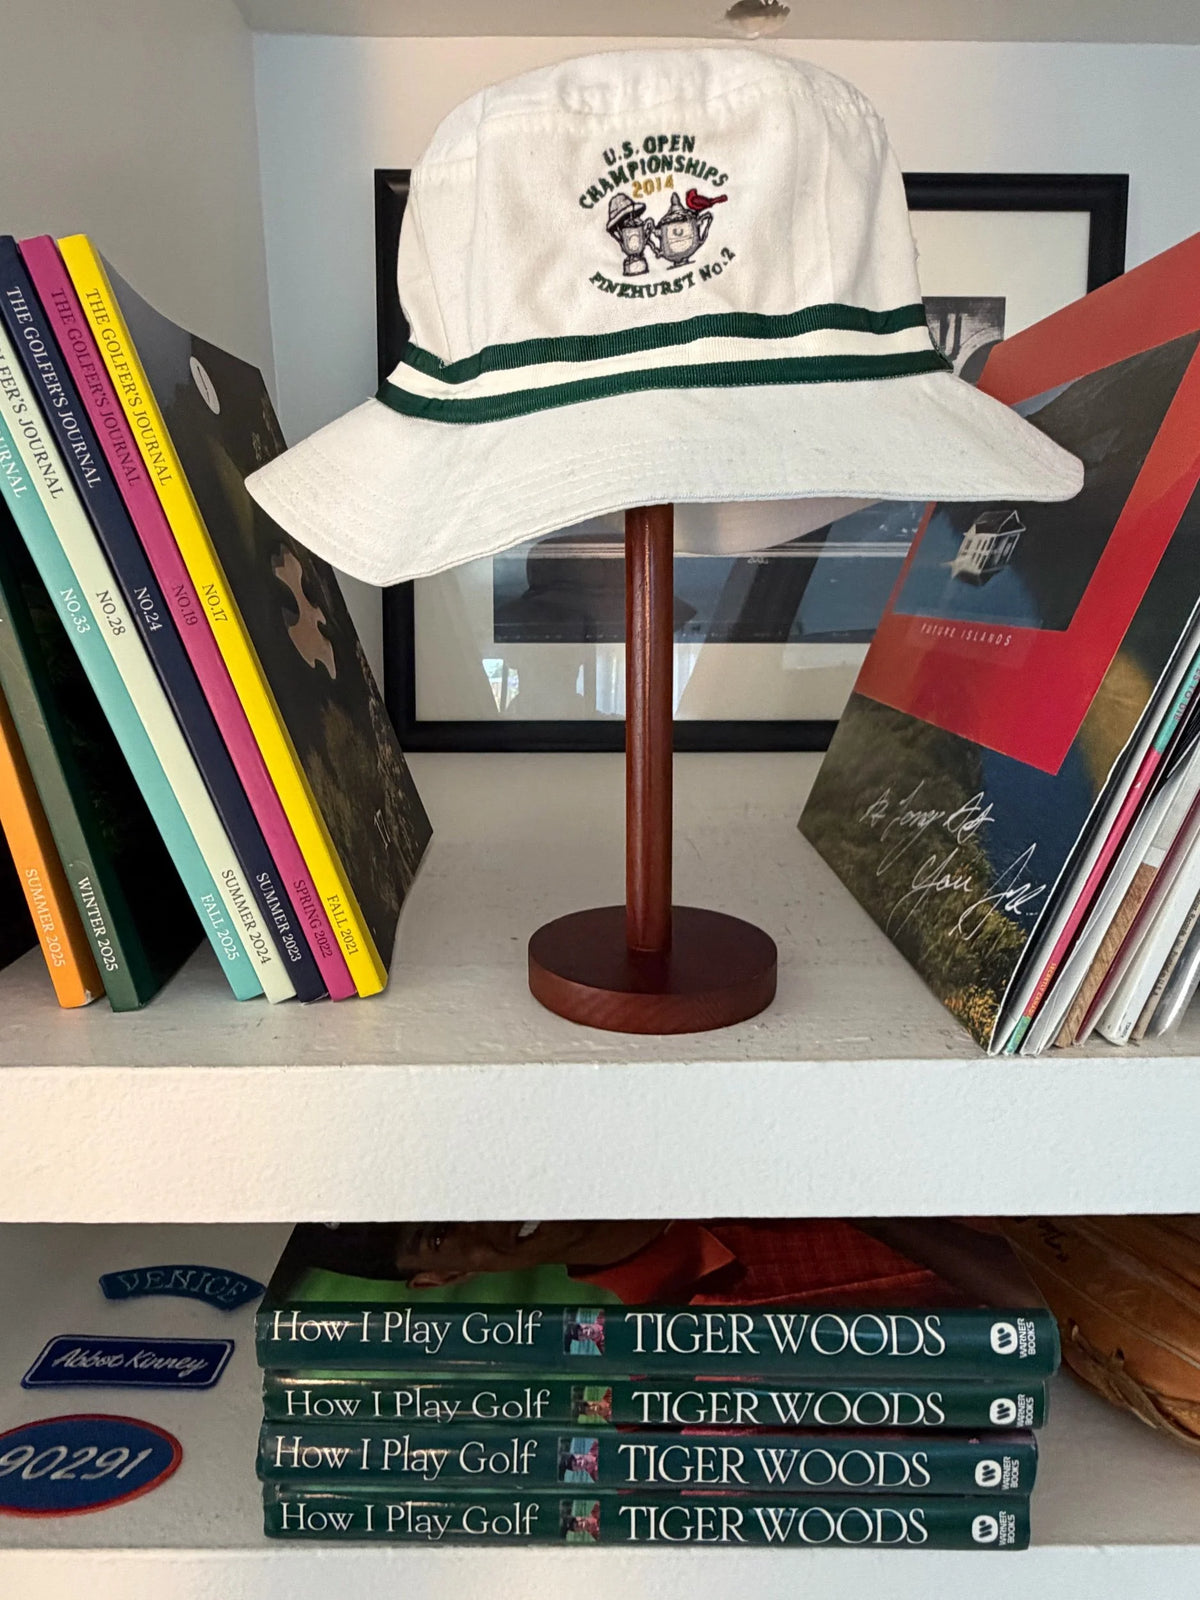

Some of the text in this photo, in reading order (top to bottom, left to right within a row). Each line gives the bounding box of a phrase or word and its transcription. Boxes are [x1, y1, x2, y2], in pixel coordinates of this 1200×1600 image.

[603, 134, 696, 167] U.S. OPEN
[578, 154, 729, 210] CHAMPIONSHIPS
[631, 174, 675, 199] 2014
[588, 271, 696, 299] PINEHURST
[6, 286, 102, 489] THE GOLFER'S JOURNAL
[51, 287, 142, 488] THE GOLFER'S JOURNAL
[86, 288, 174, 488] THE GOLFER'S JOURNAL
[0, 354, 65, 499] FER'S JOURNAL
[59, 587, 91, 634] NO.33
[95, 589, 126, 636] NO.28
[133, 586, 163, 632] NO.24
[171, 583, 199, 626] NO.19
[201, 583, 228, 623] NO.17
[960, 629, 1012, 647] ISLANDS
[25, 868, 66, 968] SUMMER 2025
[77, 876, 119, 973] WINTER 2025
[200, 892, 240, 961] FALL 2025
[221, 869, 270, 965] SUMMER 2024
[256, 871, 303, 963] SUMMER 2023
[293, 879, 333, 959] SPRING 2022
[327, 893, 358, 957] FALL 2021
[117, 1269, 248, 1303] VENICE
[270, 1308, 543, 1354] How I Play Golf
[624, 1313, 946, 1356] TIGER WOODS
[1017, 1317, 1028, 1359] WARNER
[1026, 1321, 1036, 1355] BOOKS
[124, 1349, 209, 1378] Kinney
[285, 1387, 551, 1423] How I Play Golf
[632, 1391, 945, 1426] TIGER WOODS
[0, 1445, 153, 1480] 90291
[274, 1435, 538, 1481] How I Play Golf
[618, 1444, 931, 1488] TIGER WOODS
[281, 1501, 539, 1540] How I Play Golf
[618, 1506, 928, 1544] TIGER WOODS
[998, 1510, 1007, 1546] WARNER
